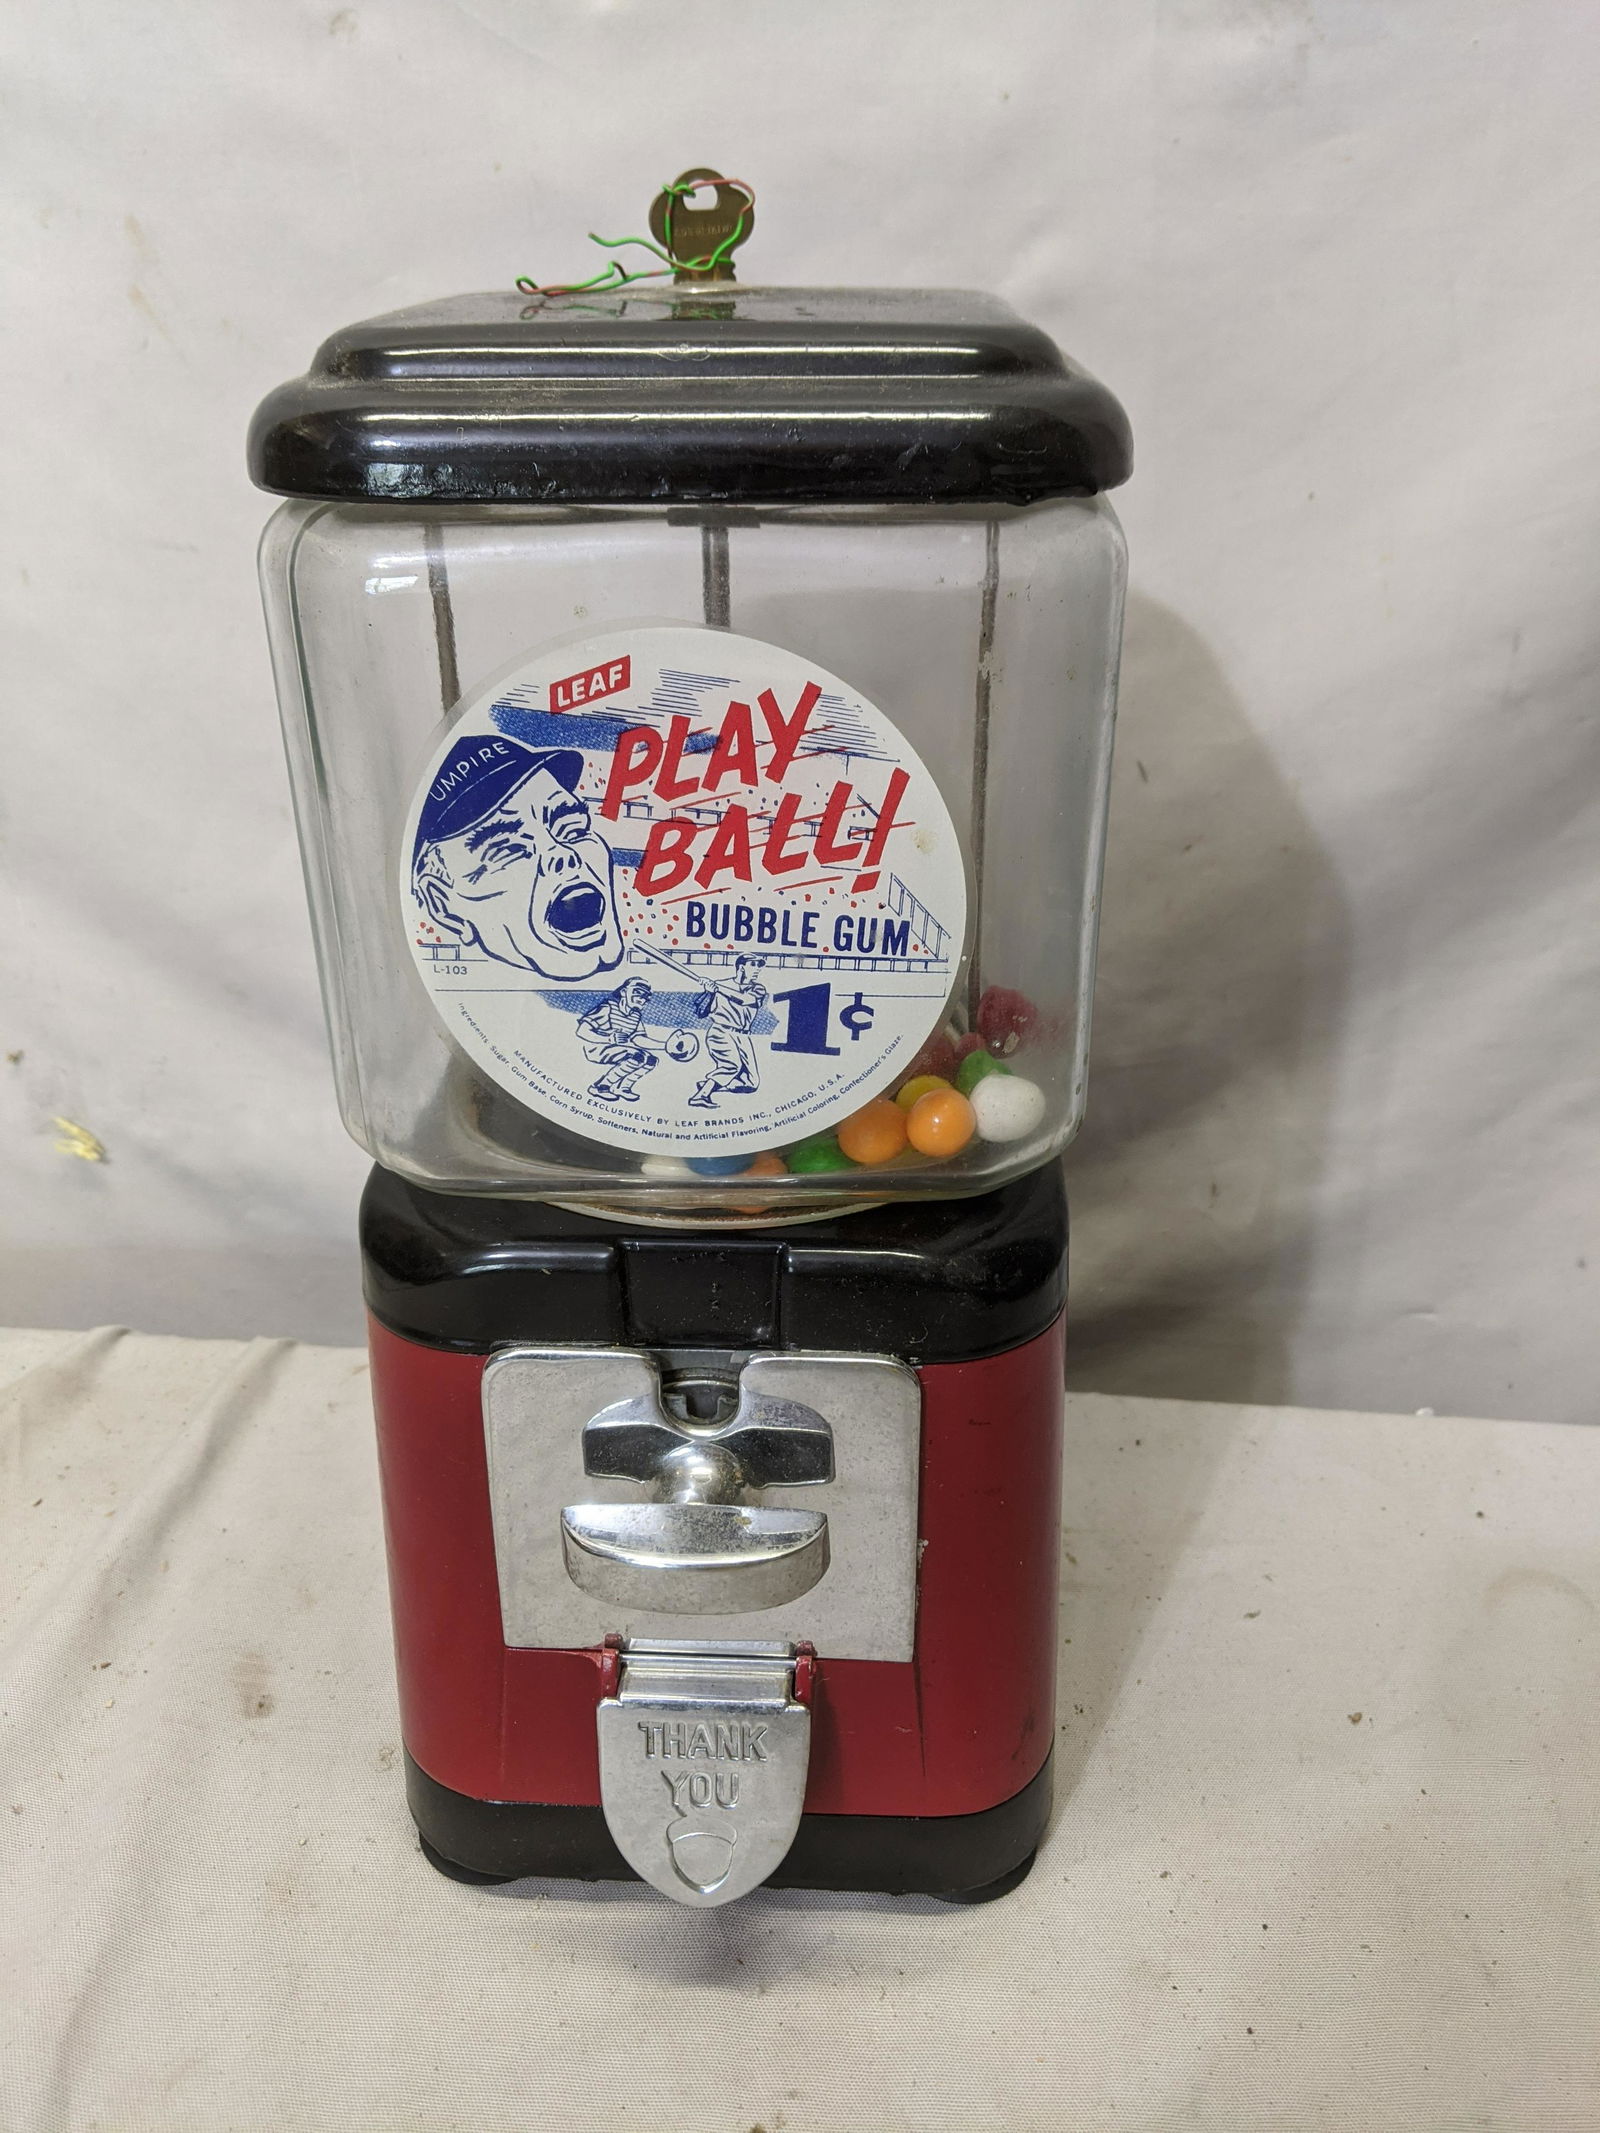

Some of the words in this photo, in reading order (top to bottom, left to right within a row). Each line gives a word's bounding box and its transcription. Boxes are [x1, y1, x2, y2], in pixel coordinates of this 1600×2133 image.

[557, 664, 624, 708] LEAF
[429, 741, 511, 801] UMPIRE
[600, 680, 823, 823] PLAY
[633, 766, 911, 897] BALL!
[686, 901, 820, 949] BUBBLE
[833, 914, 911, 957] GUM
[433, 965, 468, 975] L-103
[511, 1066, 528, 1081] Gum
[549, 1095, 568, 1109] Corn
[641, 1128, 673, 1139] Natural
[675, 1133, 691, 1141] and
[693, 1132, 729, 1142] Artificial
[773, 1111, 807, 1129] Artificial
[839, 1055, 887, 1095] Confectioner's
[513, 1049, 583, 1101] MANUFACTURED
[586, 1098, 652, 1123] EXCLUSIVELY
[656, 1117, 669, 1126] BY
[704, 1116, 744, 1127] BRANDS
[818, 1073, 845, 1092] U.S.A.
[638, 1720, 769, 1762] THANK
[661, 1770, 740, 1810] YOU
